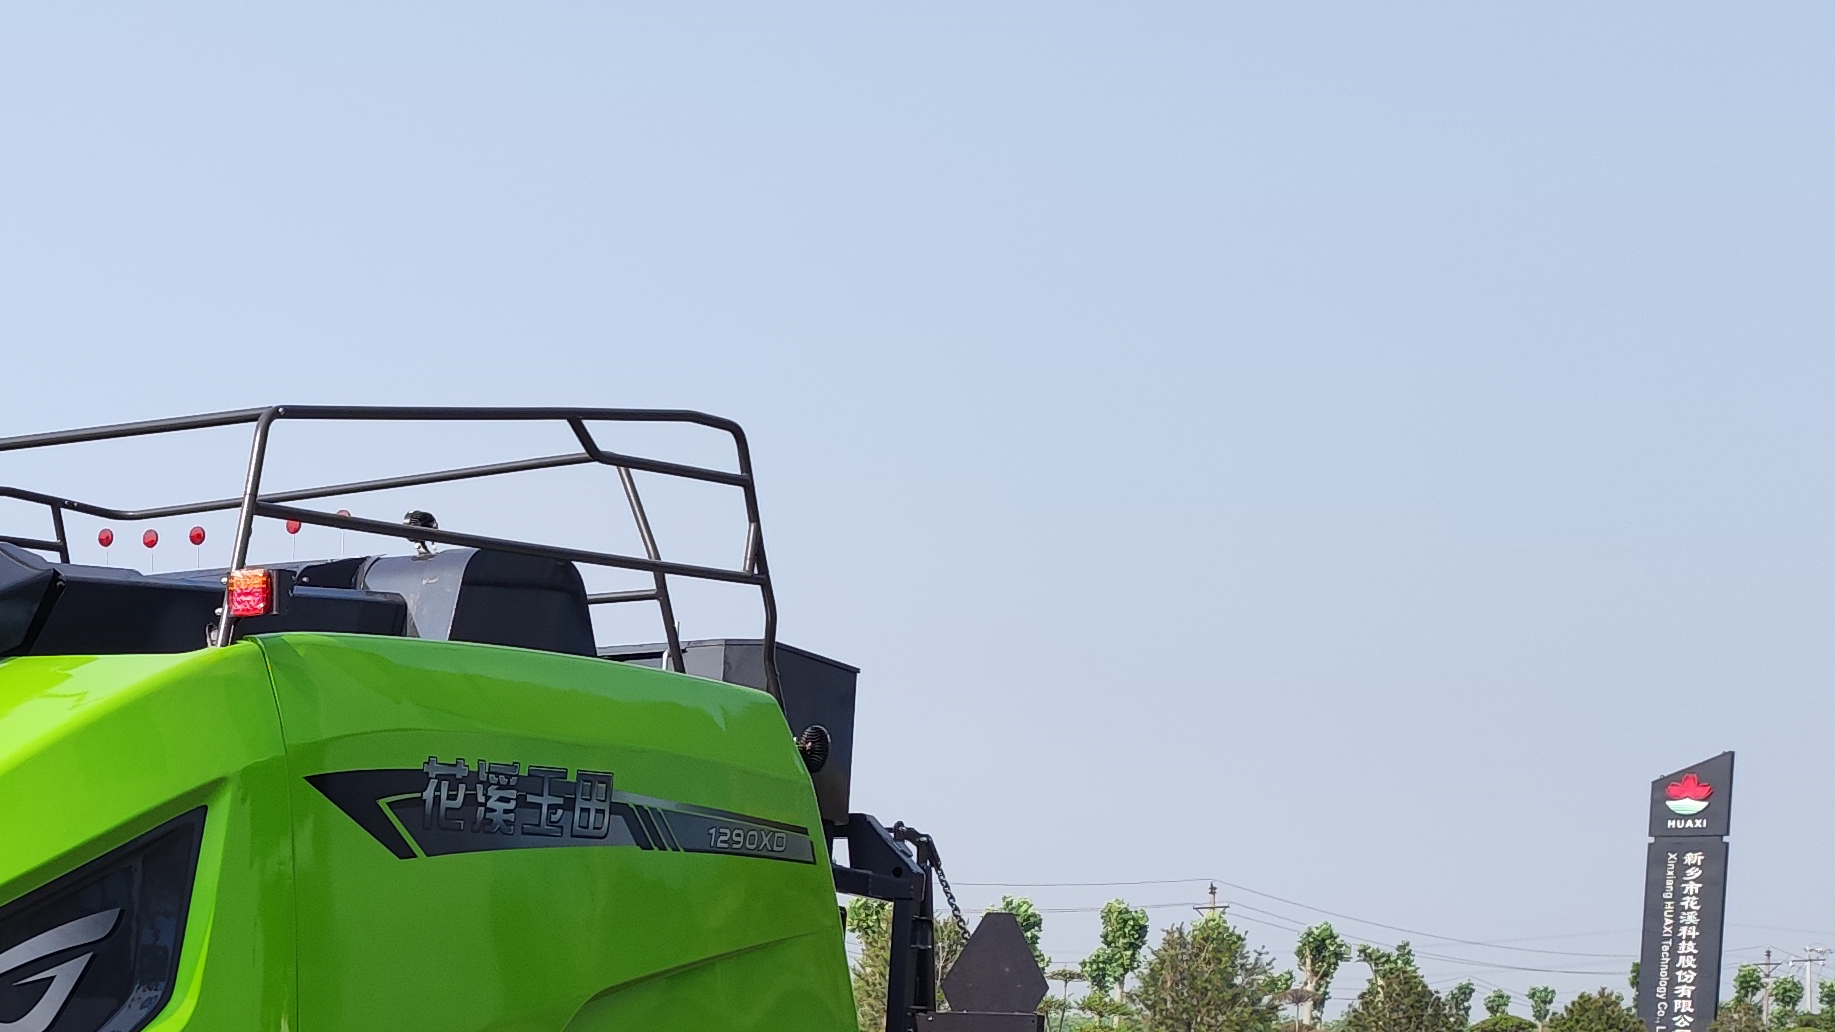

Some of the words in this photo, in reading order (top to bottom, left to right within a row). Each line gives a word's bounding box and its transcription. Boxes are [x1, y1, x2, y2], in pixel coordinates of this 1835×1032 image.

[422, 756, 614, 839] 花溪玉田
[708, 827, 787, 852] 1290XD
[1667, 818, 1707, 829] HUAXI
[1663, 852, 1678, 899] Xinxiang
[1662, 900, 1676, 937] HUAXI
[1656, 938, 1672, 1000] Technology
